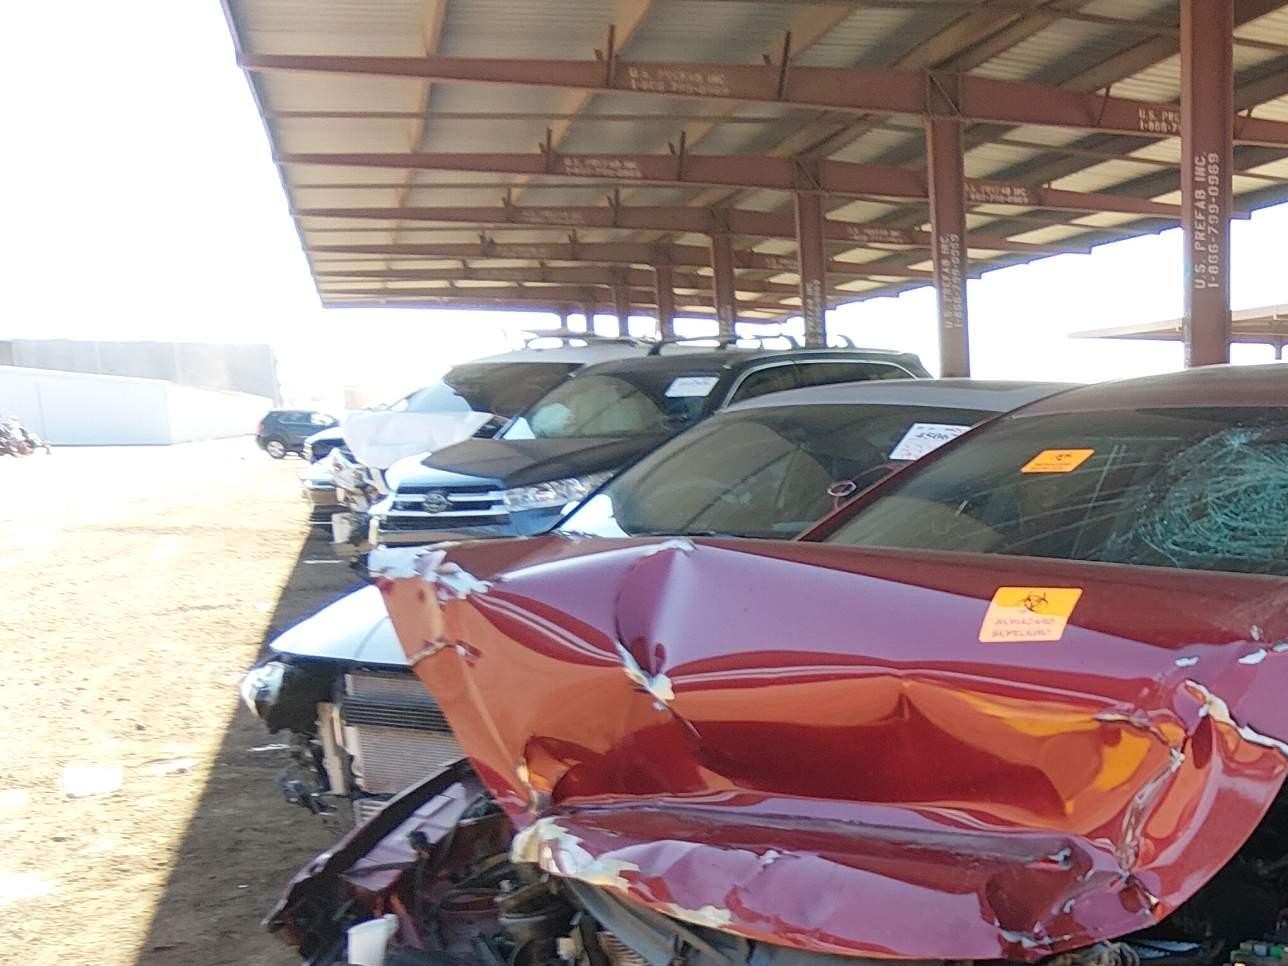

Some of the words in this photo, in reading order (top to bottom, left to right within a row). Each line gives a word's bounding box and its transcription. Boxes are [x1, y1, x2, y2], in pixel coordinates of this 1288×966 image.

[1139, 120, 1180, 133] 1-866-7
[1194, 152, 1207, 182] INC.
[1194, 189, 1206, 251] PREFAB
[1207, 152, 1220, 288] 1-866-799-0969
[1194, 259, 1206, 289] U.S.
